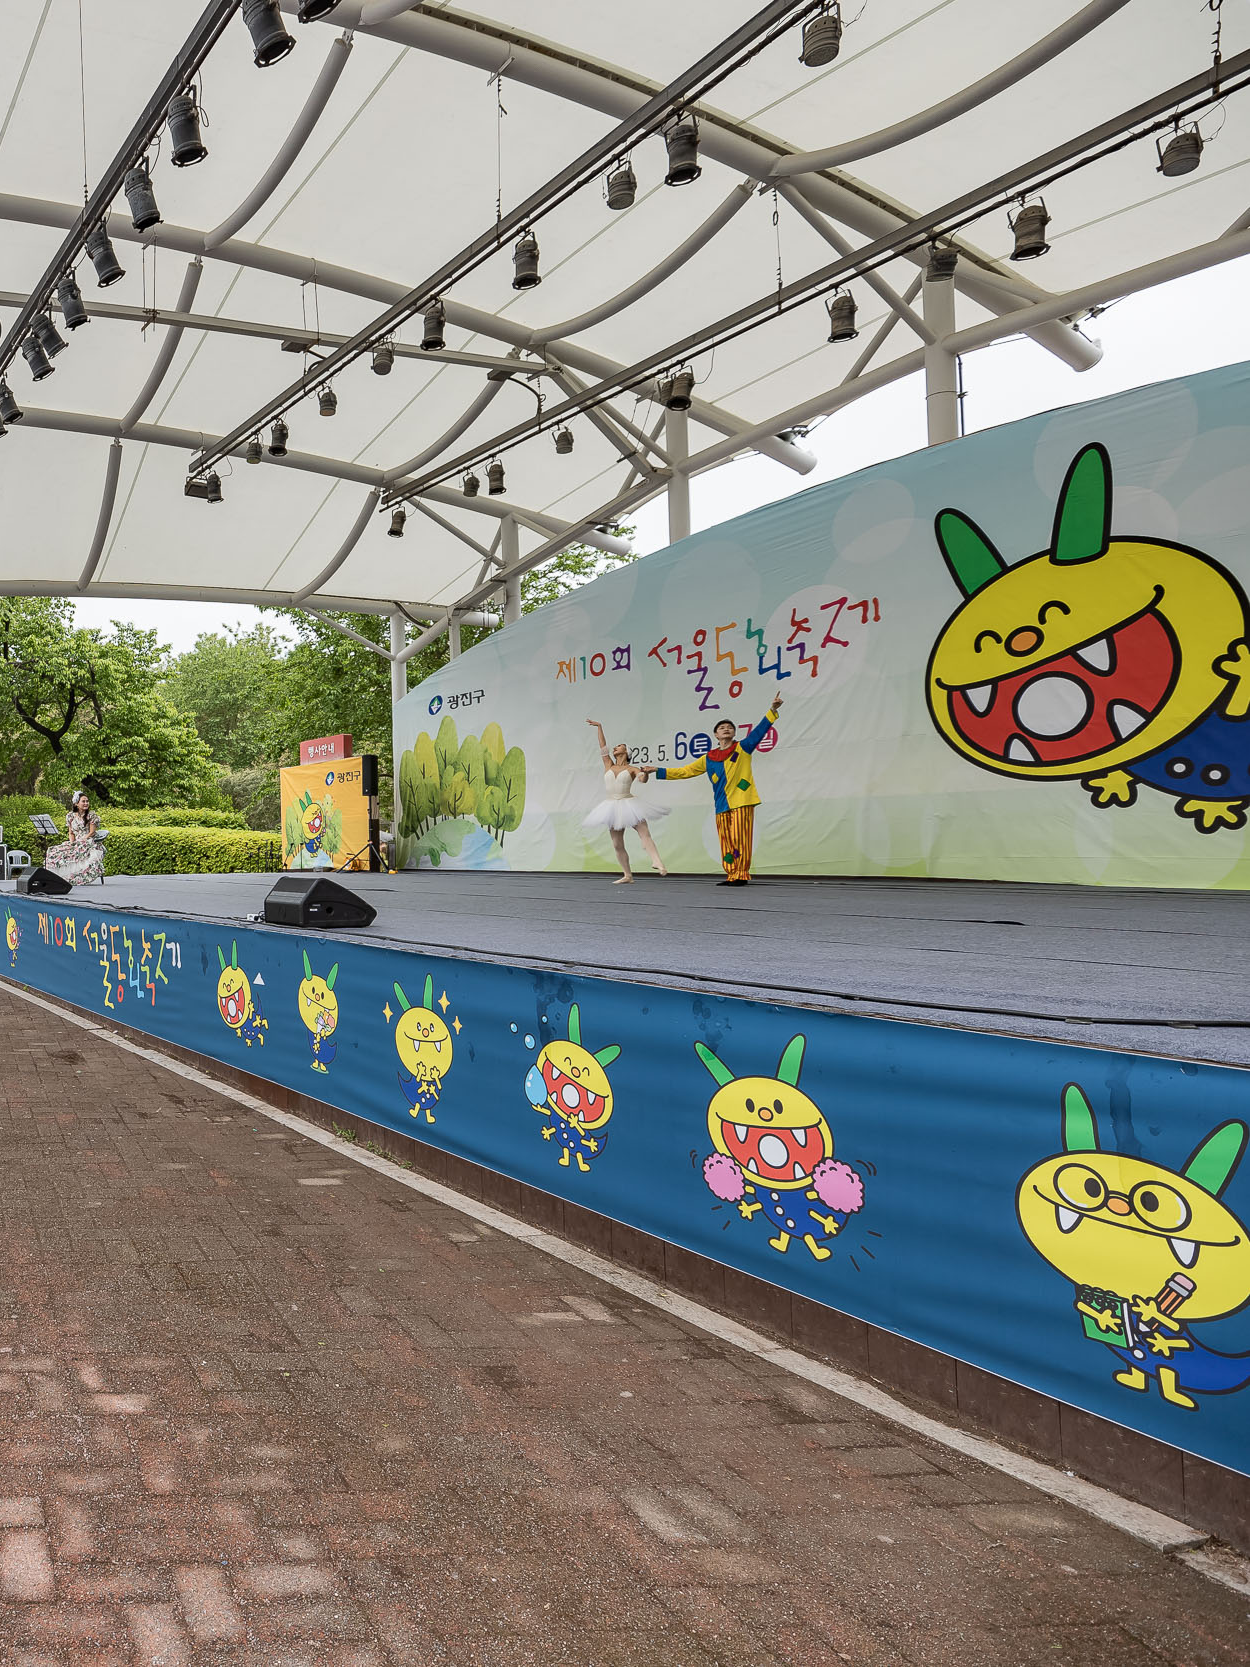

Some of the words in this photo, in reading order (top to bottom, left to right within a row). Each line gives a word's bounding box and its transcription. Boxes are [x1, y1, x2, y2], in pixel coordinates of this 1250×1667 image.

[555, 643, 631, 683] 제10회
[647, 597, 881, 711] 서울동화축제
[446, 690, 486, 710] 광진구
[307, 742, 335, 758] 행사안내
[630, 746, 653, 764] 23.
[337, 770, 361, 783] 광진구
[38, 912, 77, 952] 제10회
[83, 919, 181, 1010] 서울동화축제
